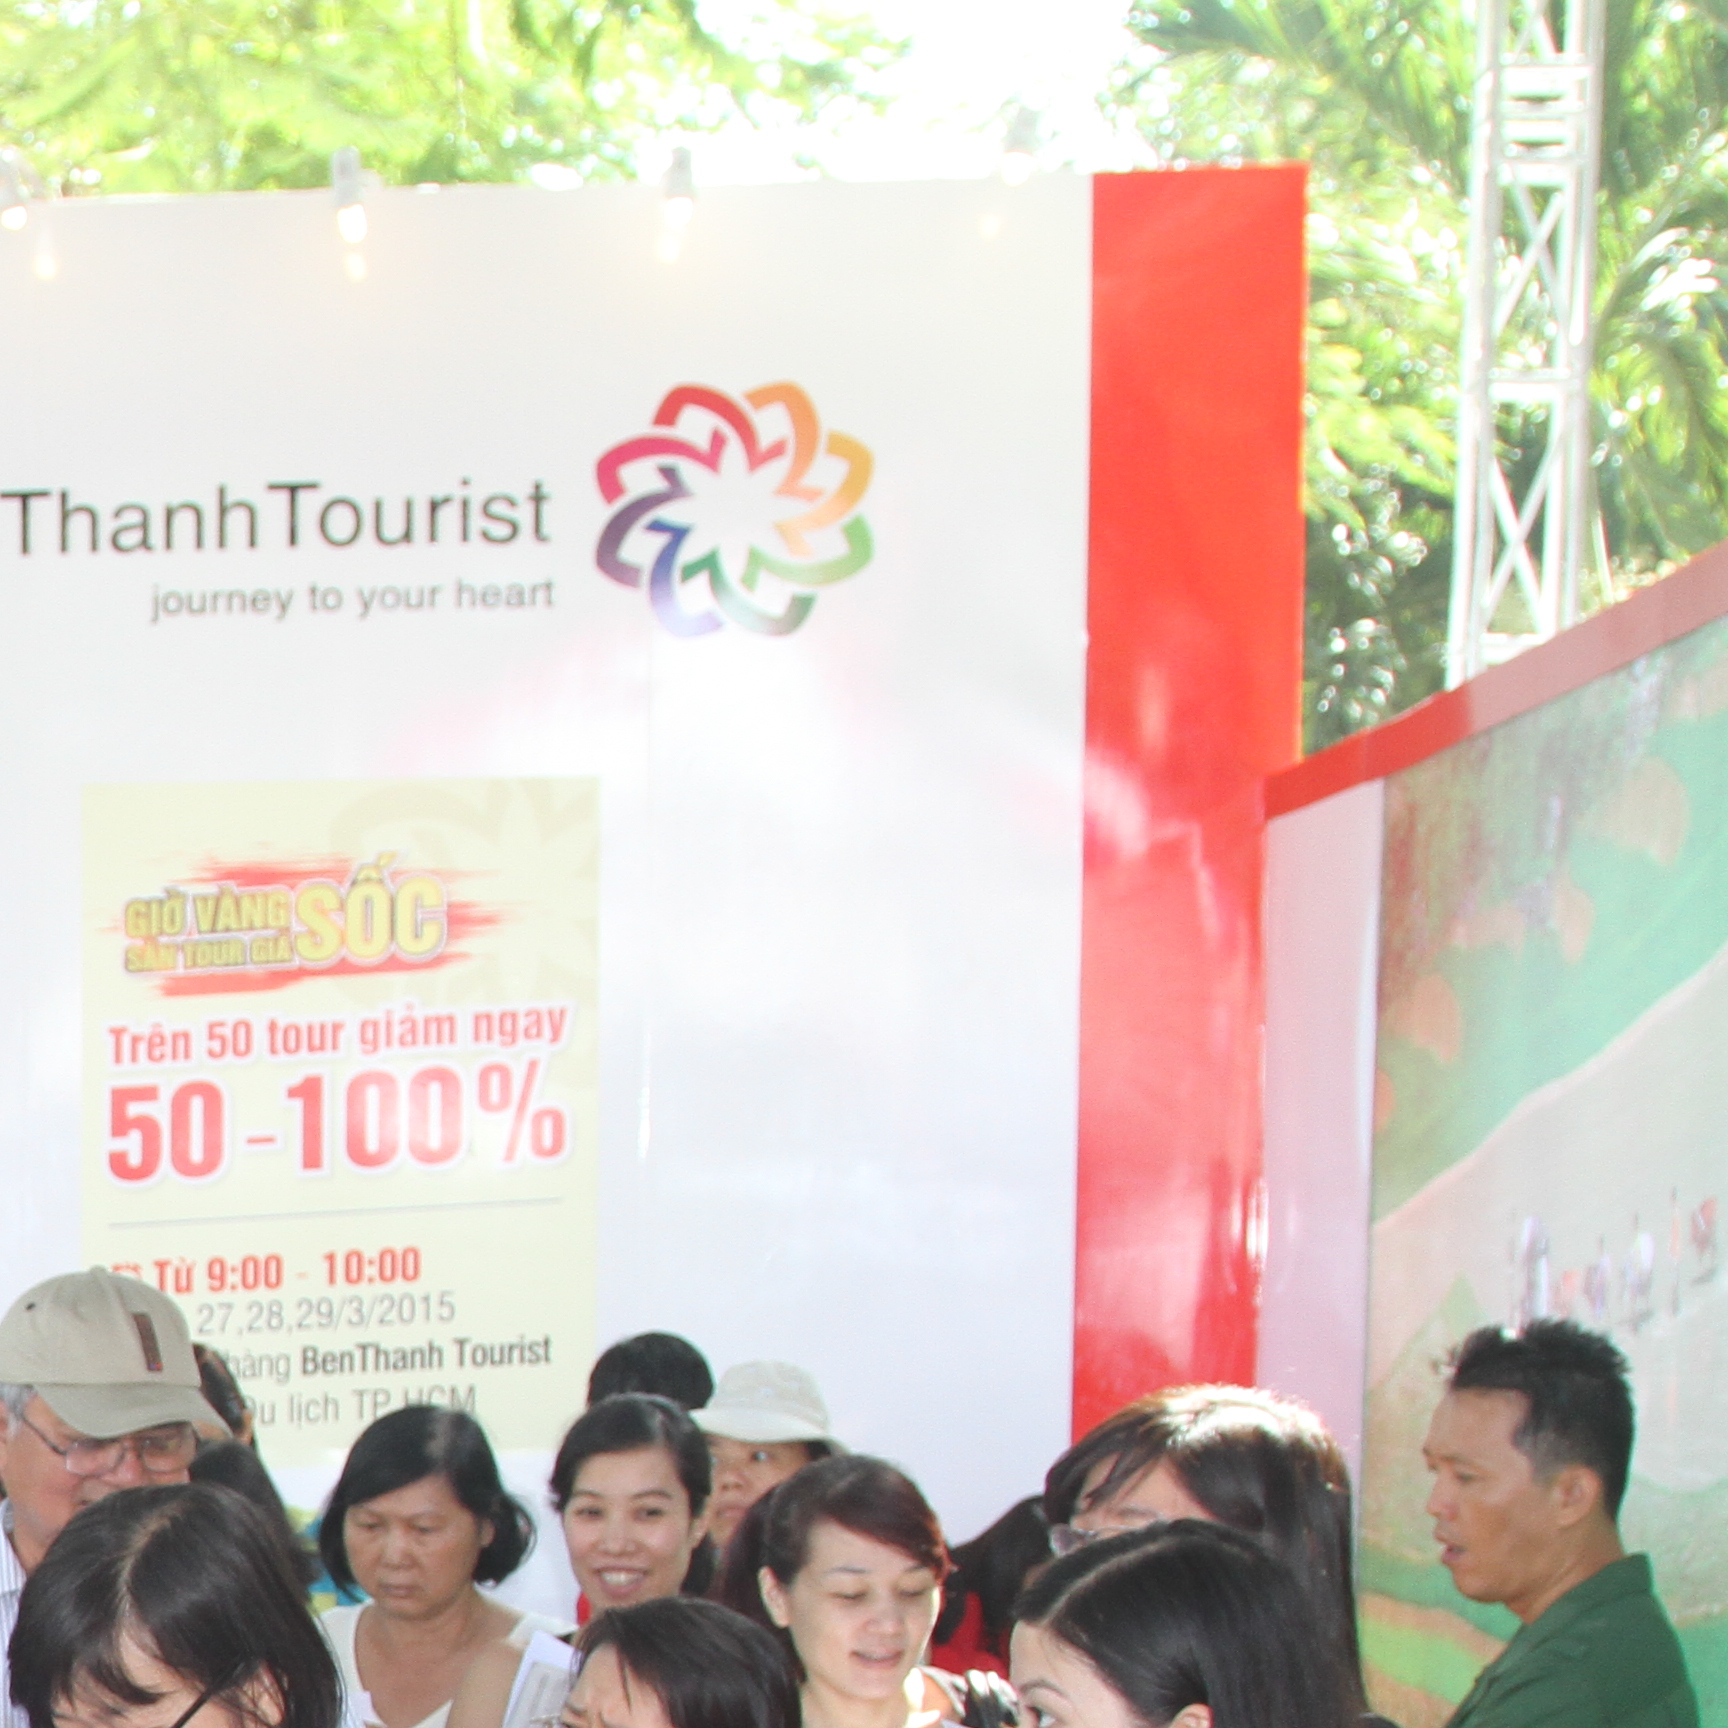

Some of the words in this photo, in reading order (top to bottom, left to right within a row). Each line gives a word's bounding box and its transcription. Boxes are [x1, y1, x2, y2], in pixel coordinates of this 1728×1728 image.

[150, 583, 295, 624] journey
[309, 580, 343, 614] to
[357, 581, 443, 618] your
[454, 576, 554, 610] heart
[194, 884, 292, 934] VÀNG
[295, 850, 445, 962] SỐC
[109, 1023, 192, 1065] Trên
[206, 1018, 254, 1060] 50
[267, 1018, 344, 1056] tour
[359, 1003, 457, 1055] giảm
[473, 1006, 568, 1050] ngay
[153, 1256, 196, 1294] Từ
[206, 1253, 284, 1292] 9:00
[323, 1246, 422, 1288] 10:00
[197, 1288, 456, 1335] 27,28,29/3/2015
[300, 1339, 444, 1377] BenThanh
[453, 1334, 552, 1370] Tourist
